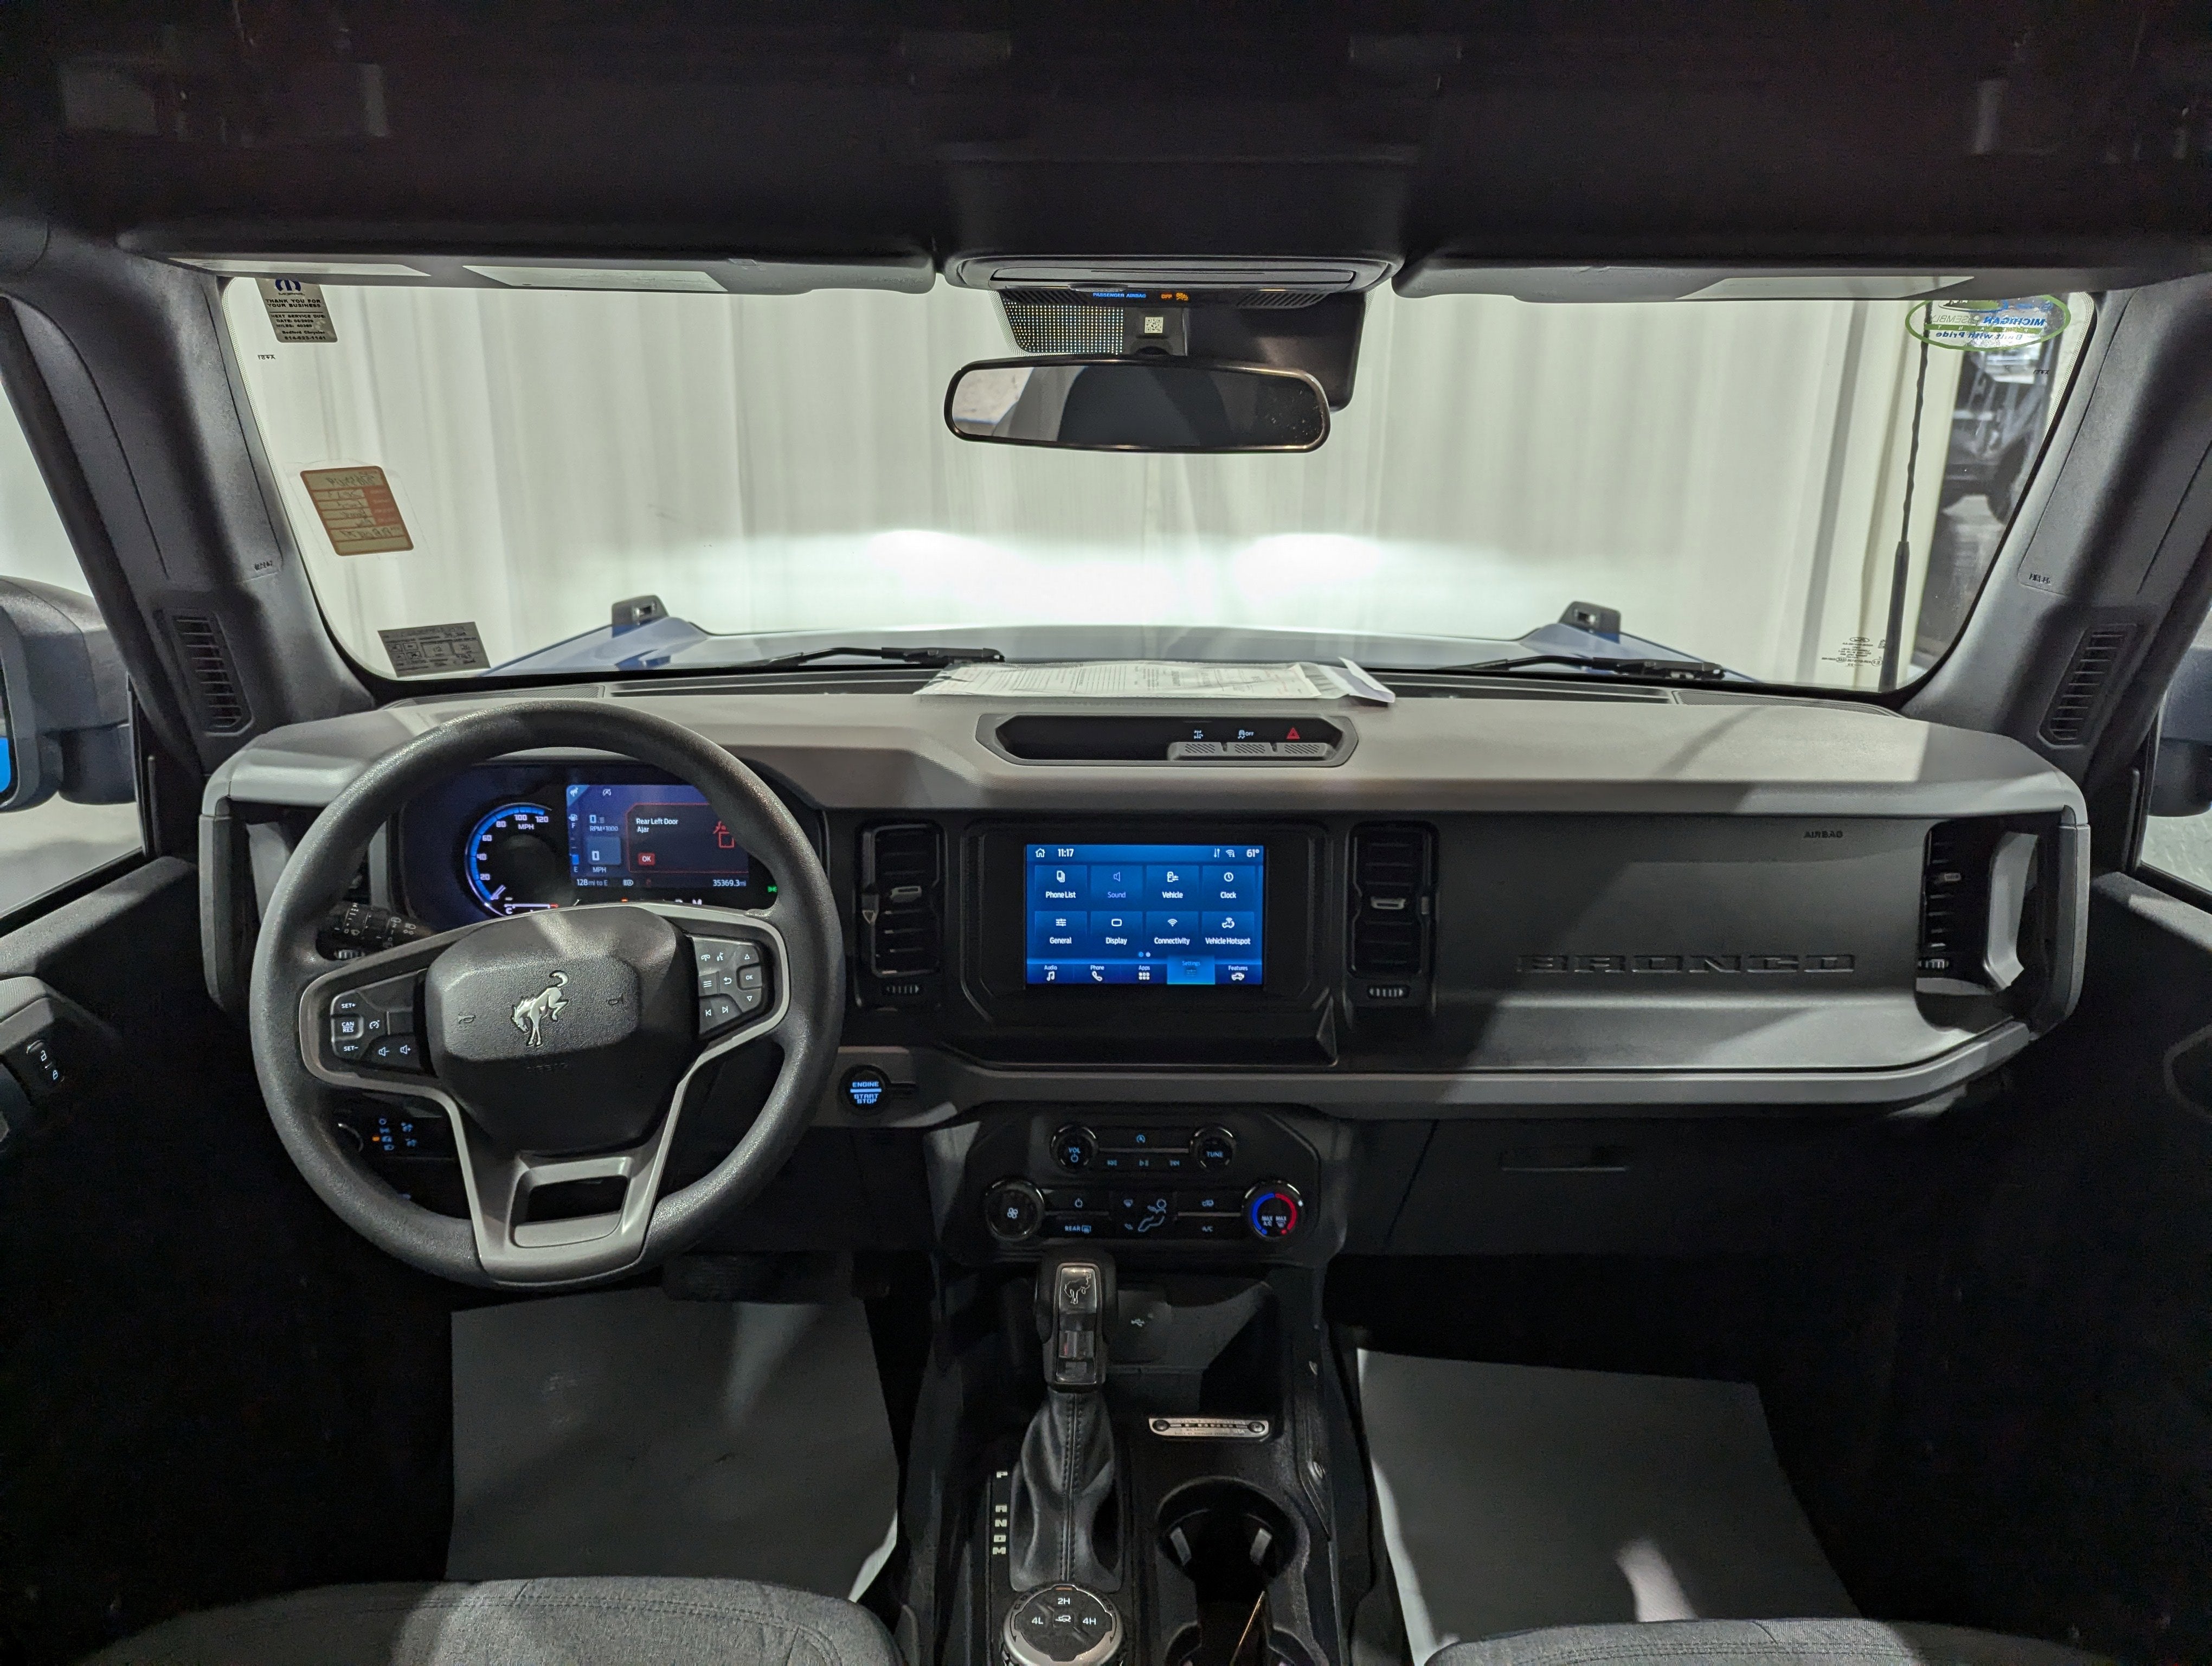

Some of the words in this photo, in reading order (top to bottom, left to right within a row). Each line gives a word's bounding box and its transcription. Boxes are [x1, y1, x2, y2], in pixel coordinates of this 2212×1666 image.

[592, 851, 600, 861] 0
[1057, 849, 1074, 857] 11:17
[1105, 937, 1128, 946] Display
[1154, 937, 1191, 946] Connectivity
[1226, 937, 1251, 946] Hotspot
[1519, 953, 1855, 973] BRONCO
[1206, 1150, 1224, 1158] TUNE
[994, 1519, 1007, 1527] N
[992, 1547, 1006, 1555] M
[1082, 1617, 1097, 1625] 4H
